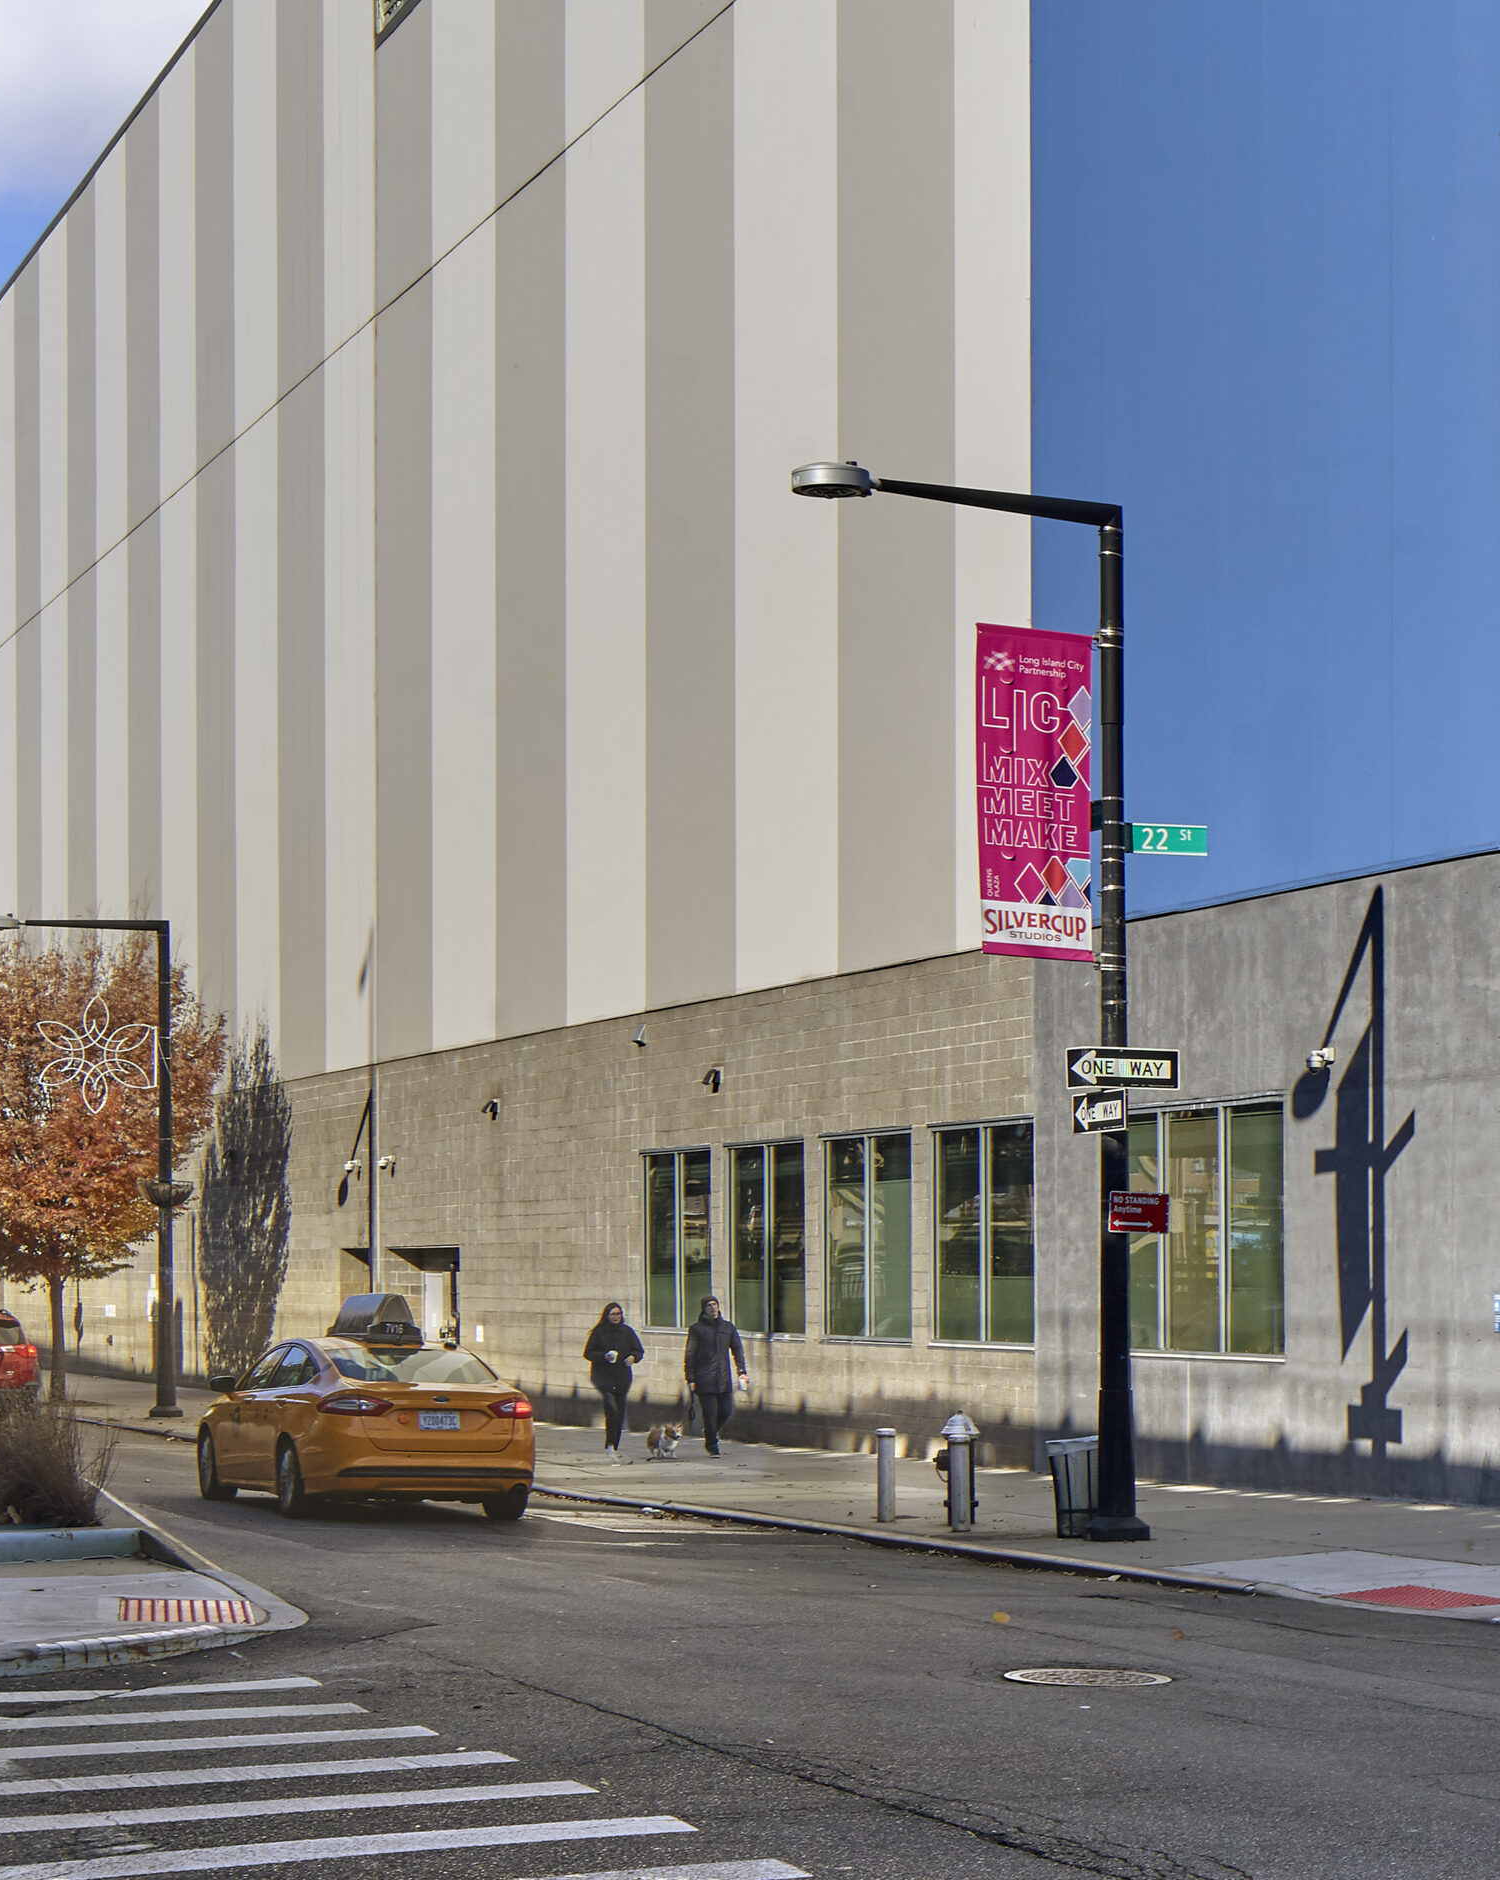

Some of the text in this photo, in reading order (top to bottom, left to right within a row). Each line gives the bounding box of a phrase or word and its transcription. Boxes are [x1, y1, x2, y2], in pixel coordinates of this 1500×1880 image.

[1019, 654, 1084, 672] Long Island City
[1019, 665, 1067, 680] Partnership
[982, 676, 1060, 751] LIC
[983, 742, 1049, 787] MIX
[984, 788, 1075, 821] MEET
[984, 817, 1077, 851] MAKE
[1141, 827, 1192, 850] 22 St
[984, 908, 1087, 942] SILVERCUP
[1009, 931, 1062, 942] STUDIOS
[1081, 1060, 1163, 1076] ONE WAY
[1080, 1102, 1119, 1120] ONE WAY
[1113, 1195, 1160, 1205] NO STANDING
[1113, 1205, 1142, 1214] Anytime
